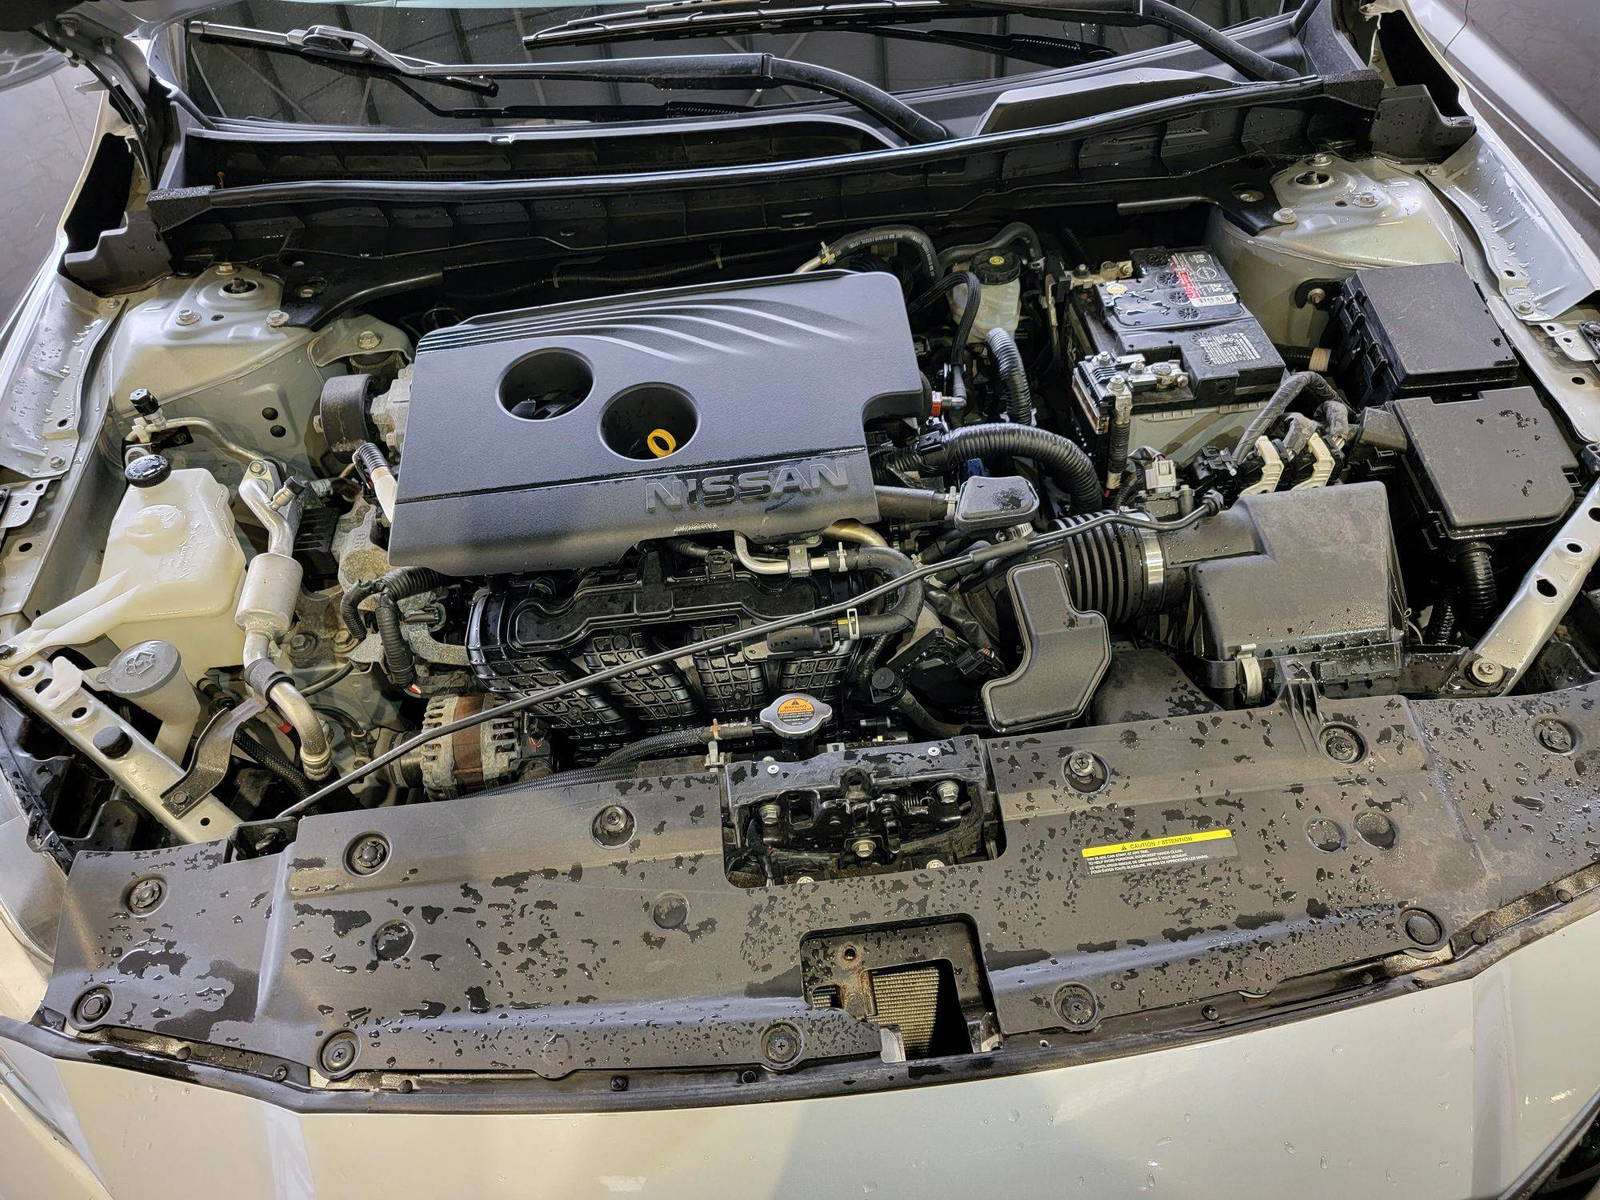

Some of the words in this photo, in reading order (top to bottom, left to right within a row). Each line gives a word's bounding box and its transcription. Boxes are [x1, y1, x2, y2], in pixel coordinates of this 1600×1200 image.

[646, 462, 849, 512] NISSAN
[1129, 841, 1156, 849] CAUTION
[1161, 836, 1193, 845] ATTENTION
